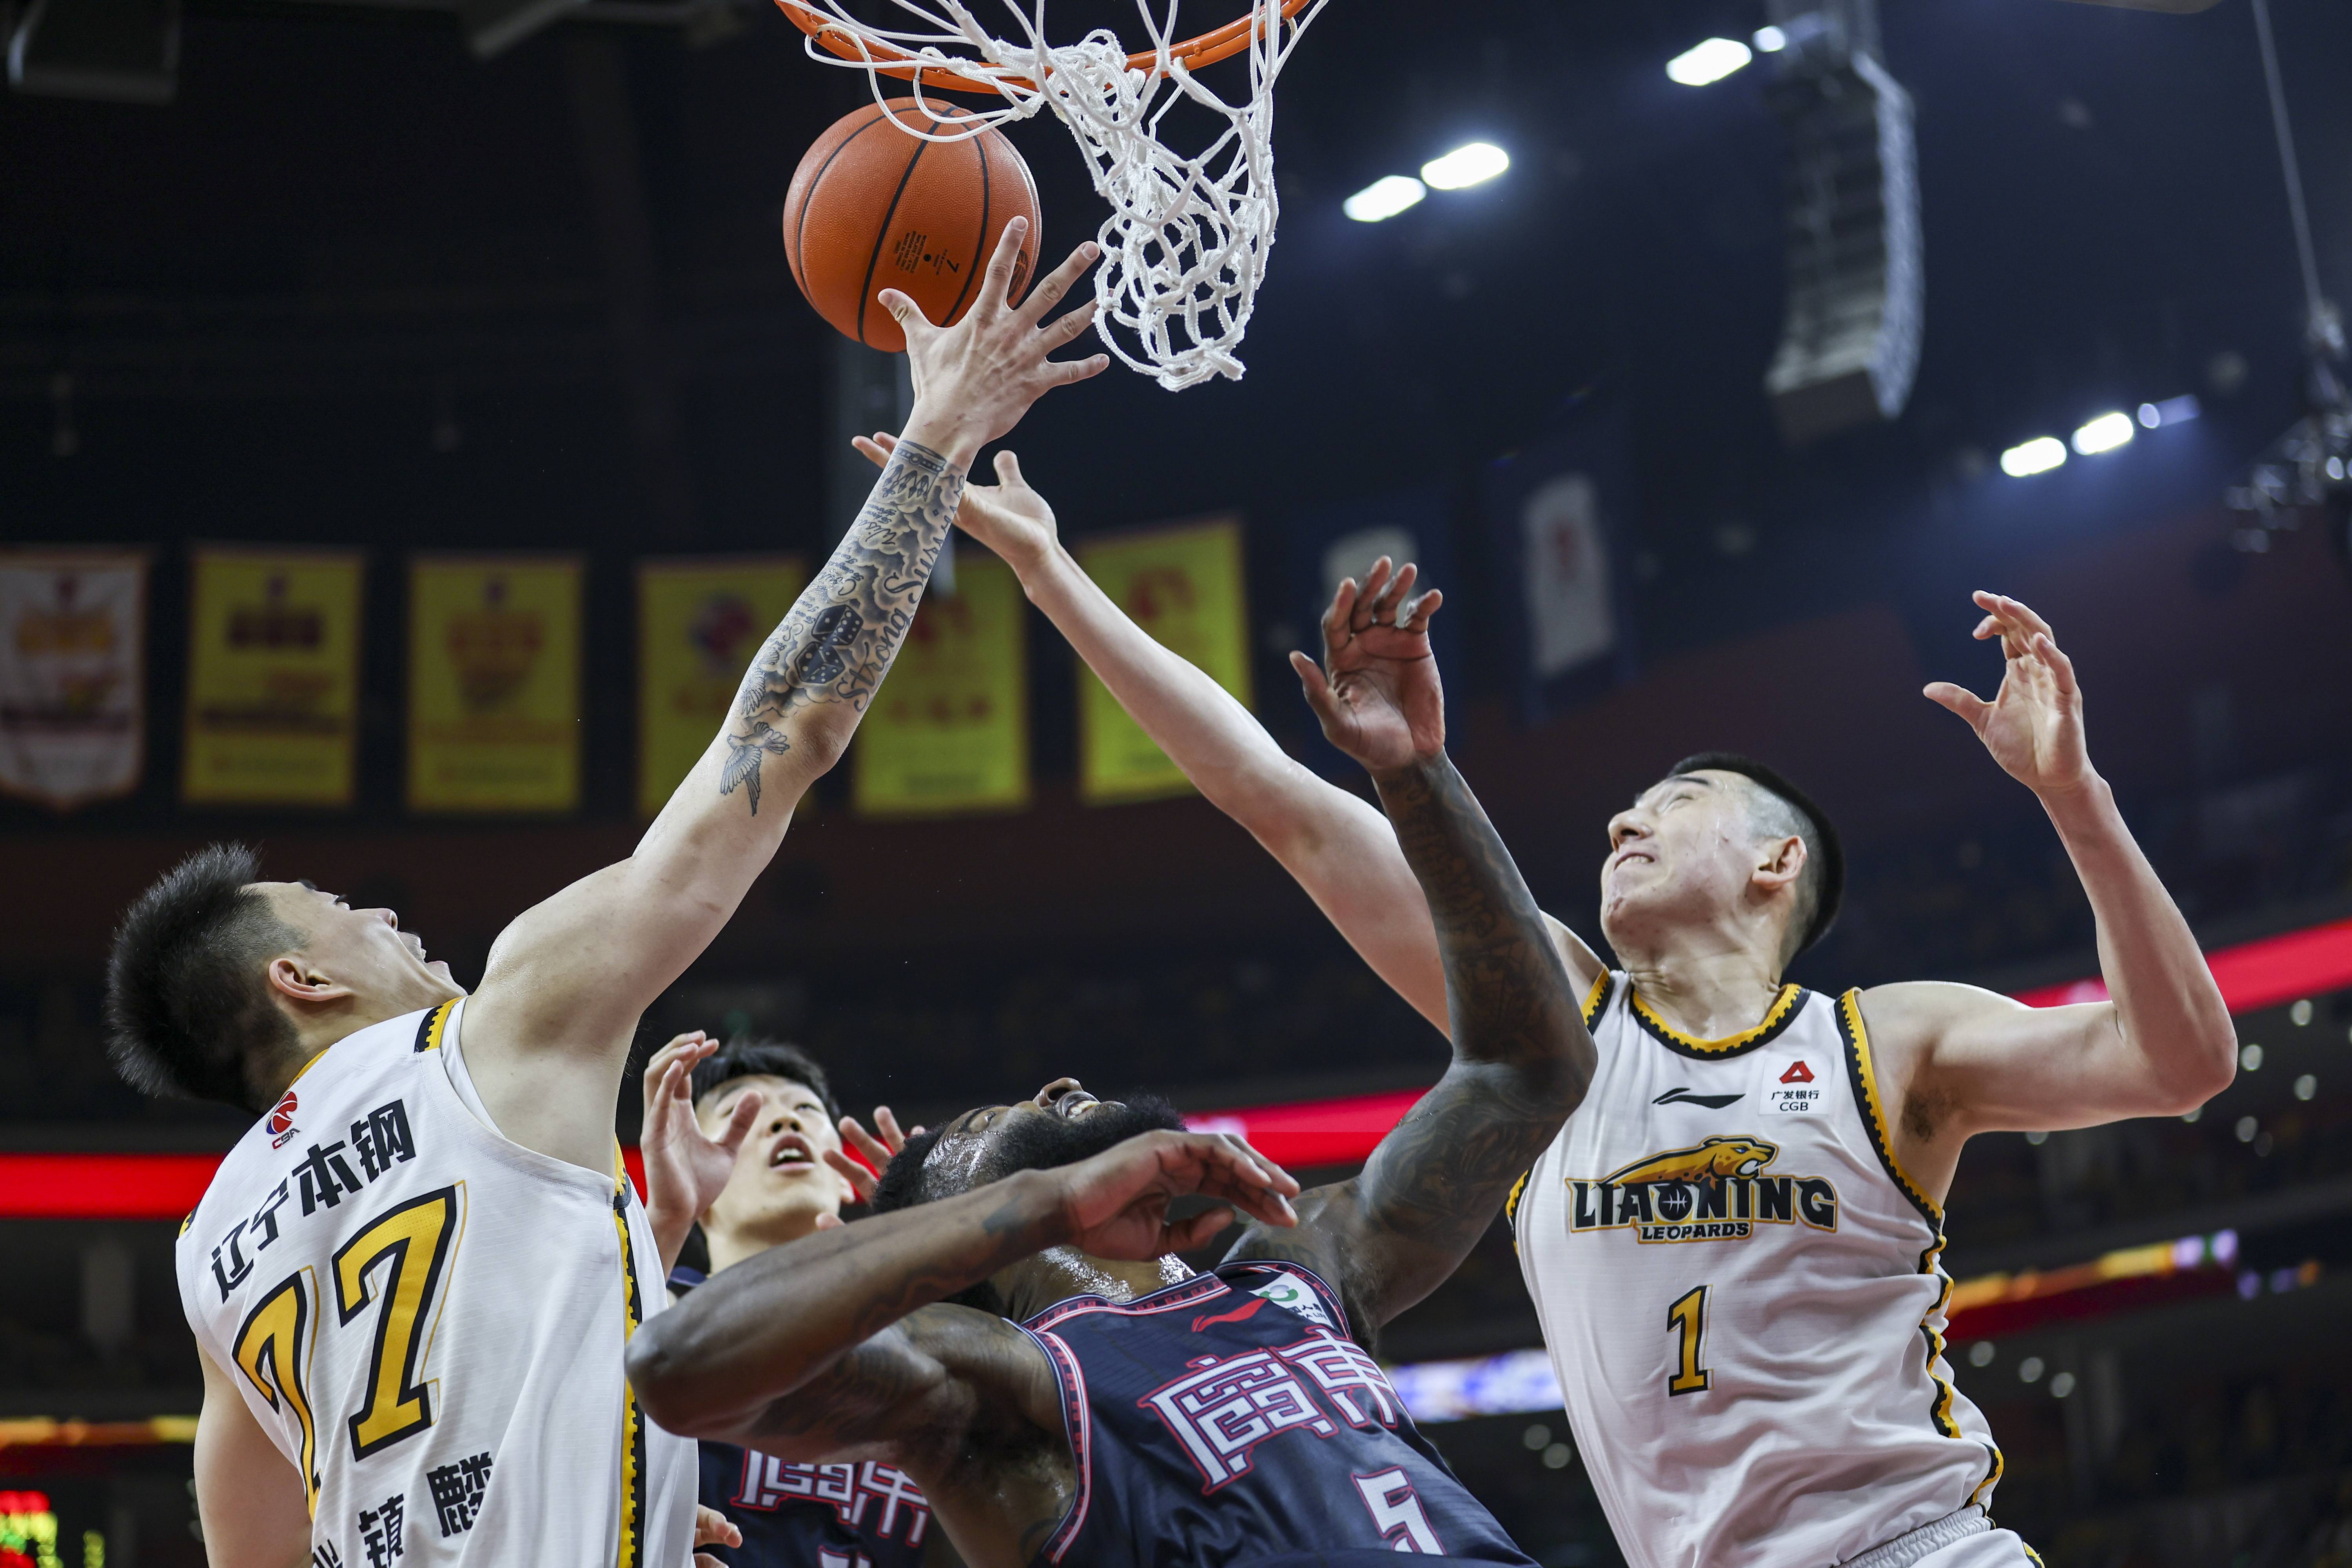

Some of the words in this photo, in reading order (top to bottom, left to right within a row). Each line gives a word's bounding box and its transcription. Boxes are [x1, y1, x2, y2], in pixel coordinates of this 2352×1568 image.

[947, 259, 960, 273] 7
[836, 607, 913, 712] Strong
[1771, 1090, 1820, 1100] 广发银行
[1780, 1102, 1809, 1111] CGB
[272, 1127, 301, 1150] CBA
[211, 1099, 416, 1305] 辽宁本钢
[1570, 1176, 1836, 1230] LIAONING
[1639, 1222, 1750, 1241] LEOPARDS
[1667, 1285, 1713, 1396] 1
[1350, 1465, 1448, 1556] 5
